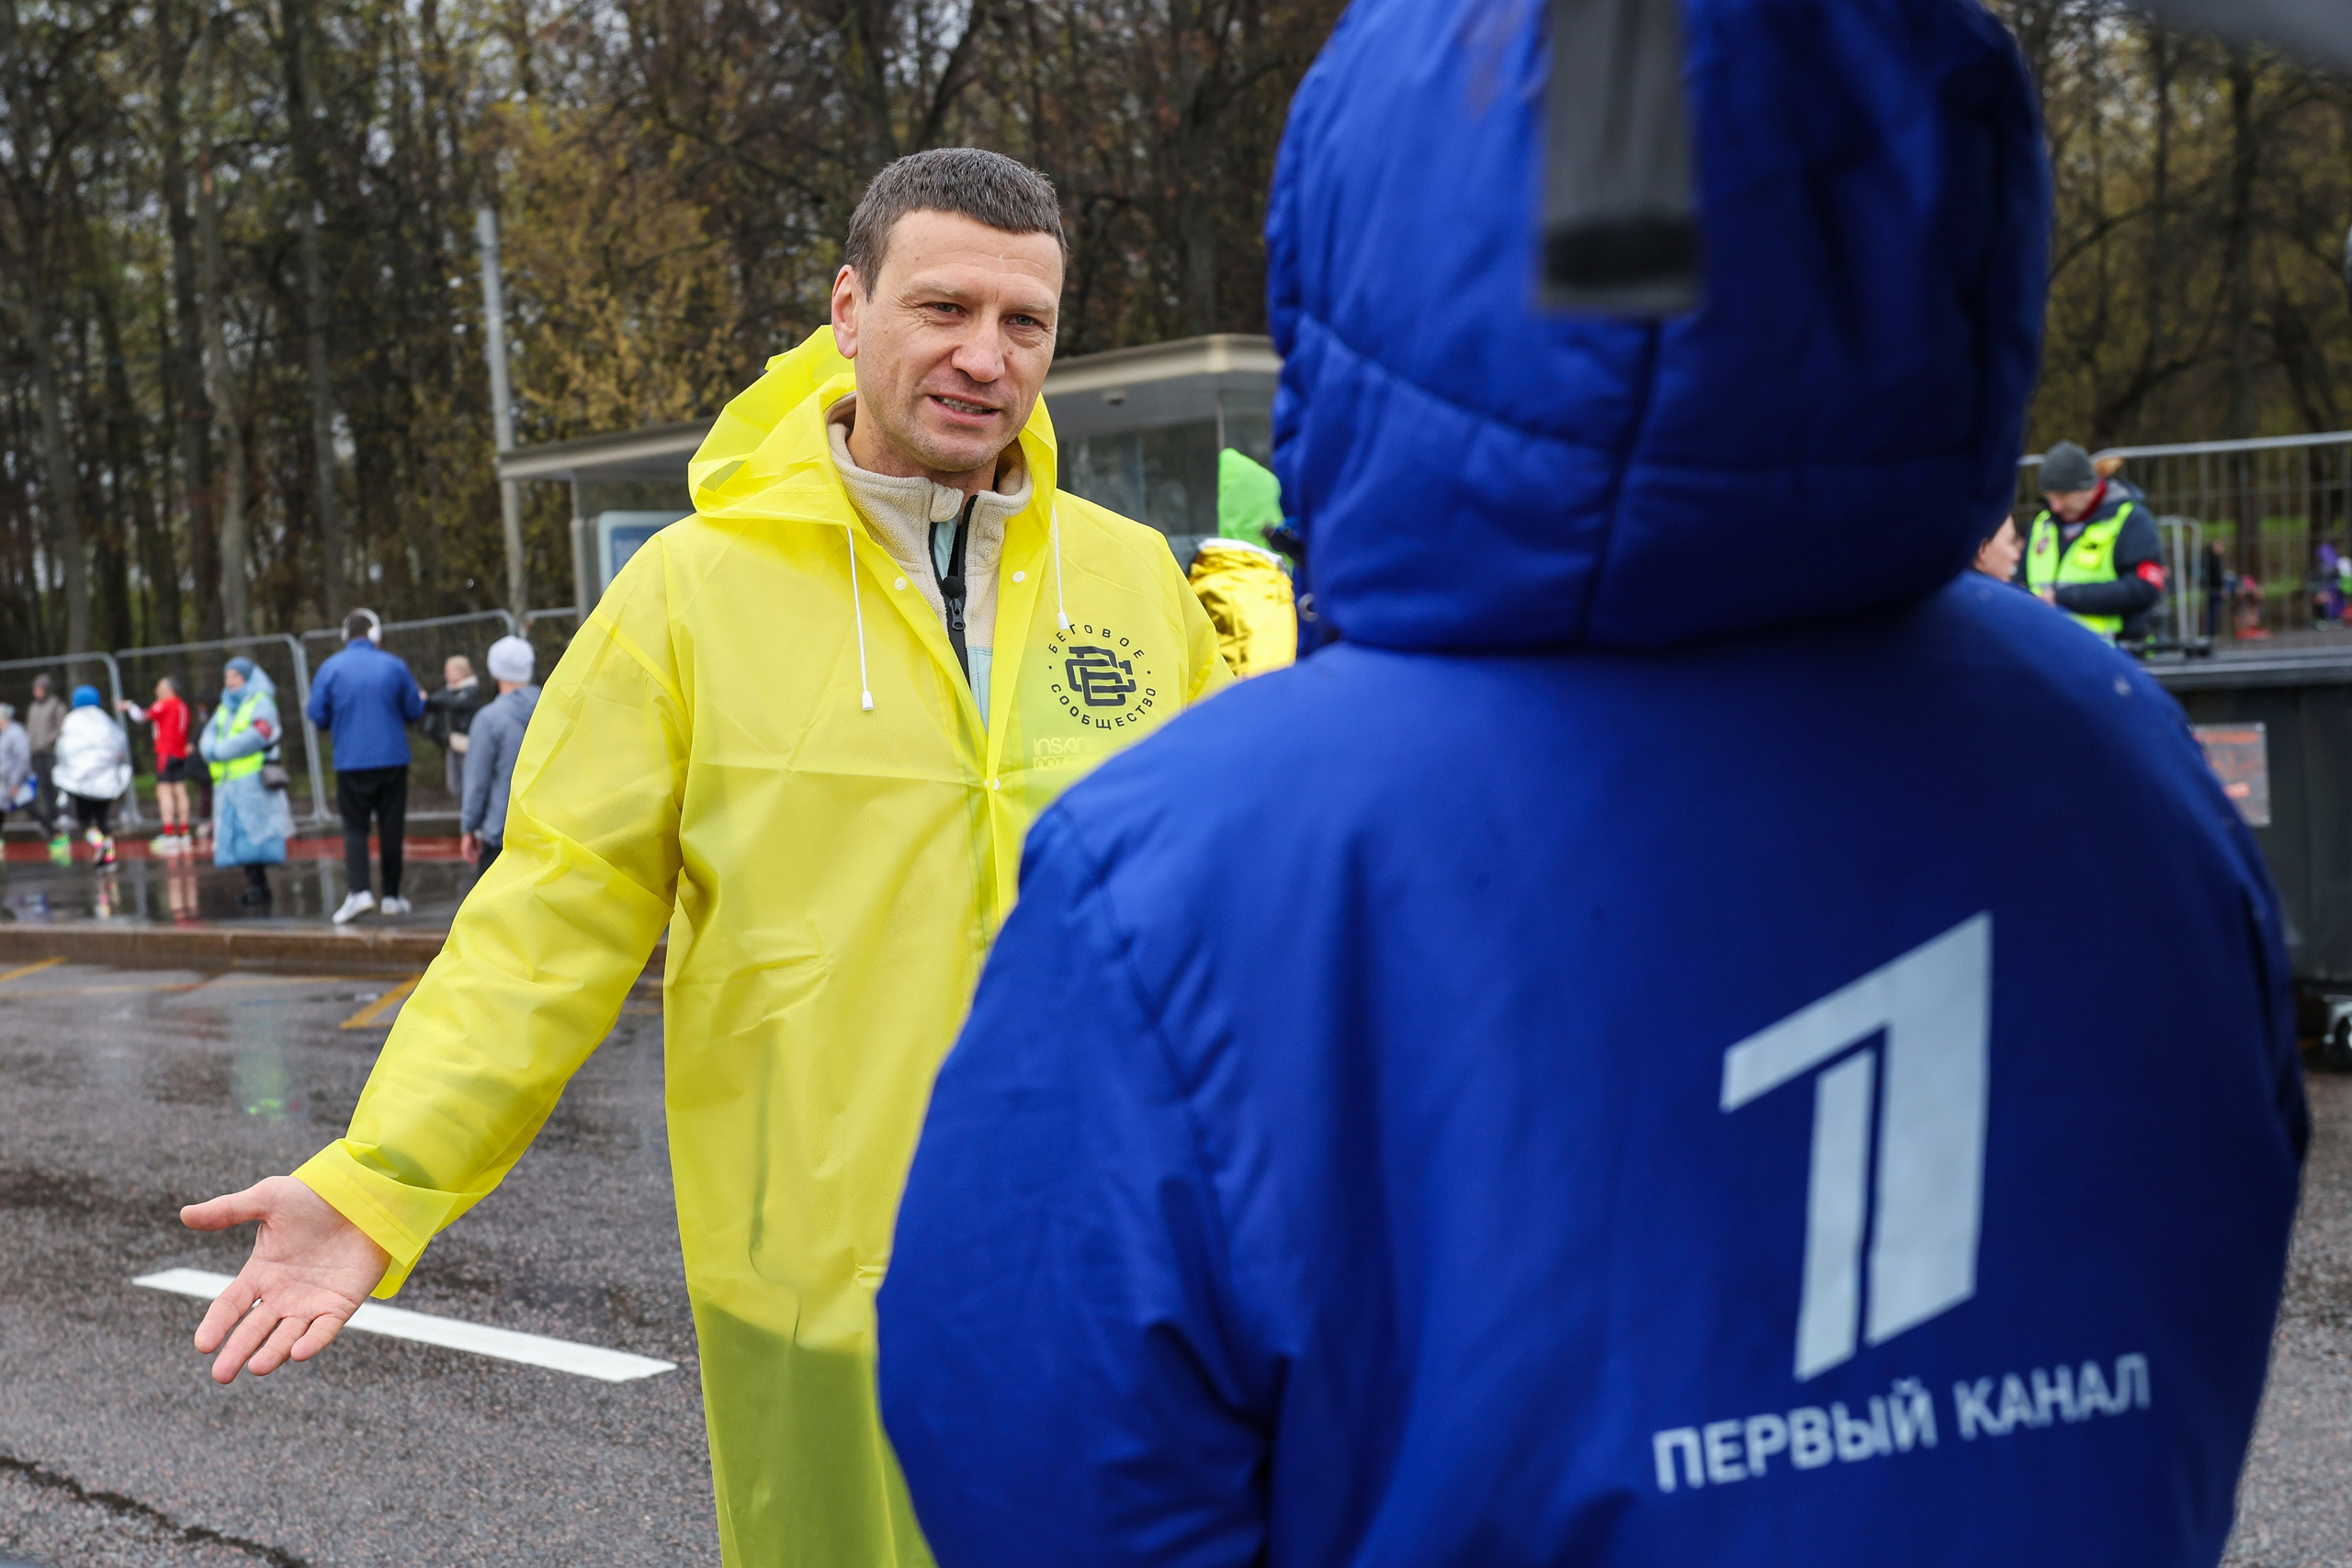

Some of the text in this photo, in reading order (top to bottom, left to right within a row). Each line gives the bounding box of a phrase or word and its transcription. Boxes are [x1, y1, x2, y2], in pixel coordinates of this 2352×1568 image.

[1048, 624, 1145, 660] БЕГОВОЕ
[1051, 683, 1156, 730] СООБЩЕСТВО
[1654, 1351, 2152, 1494] ПЕРВЫЙ КАНАЛ
